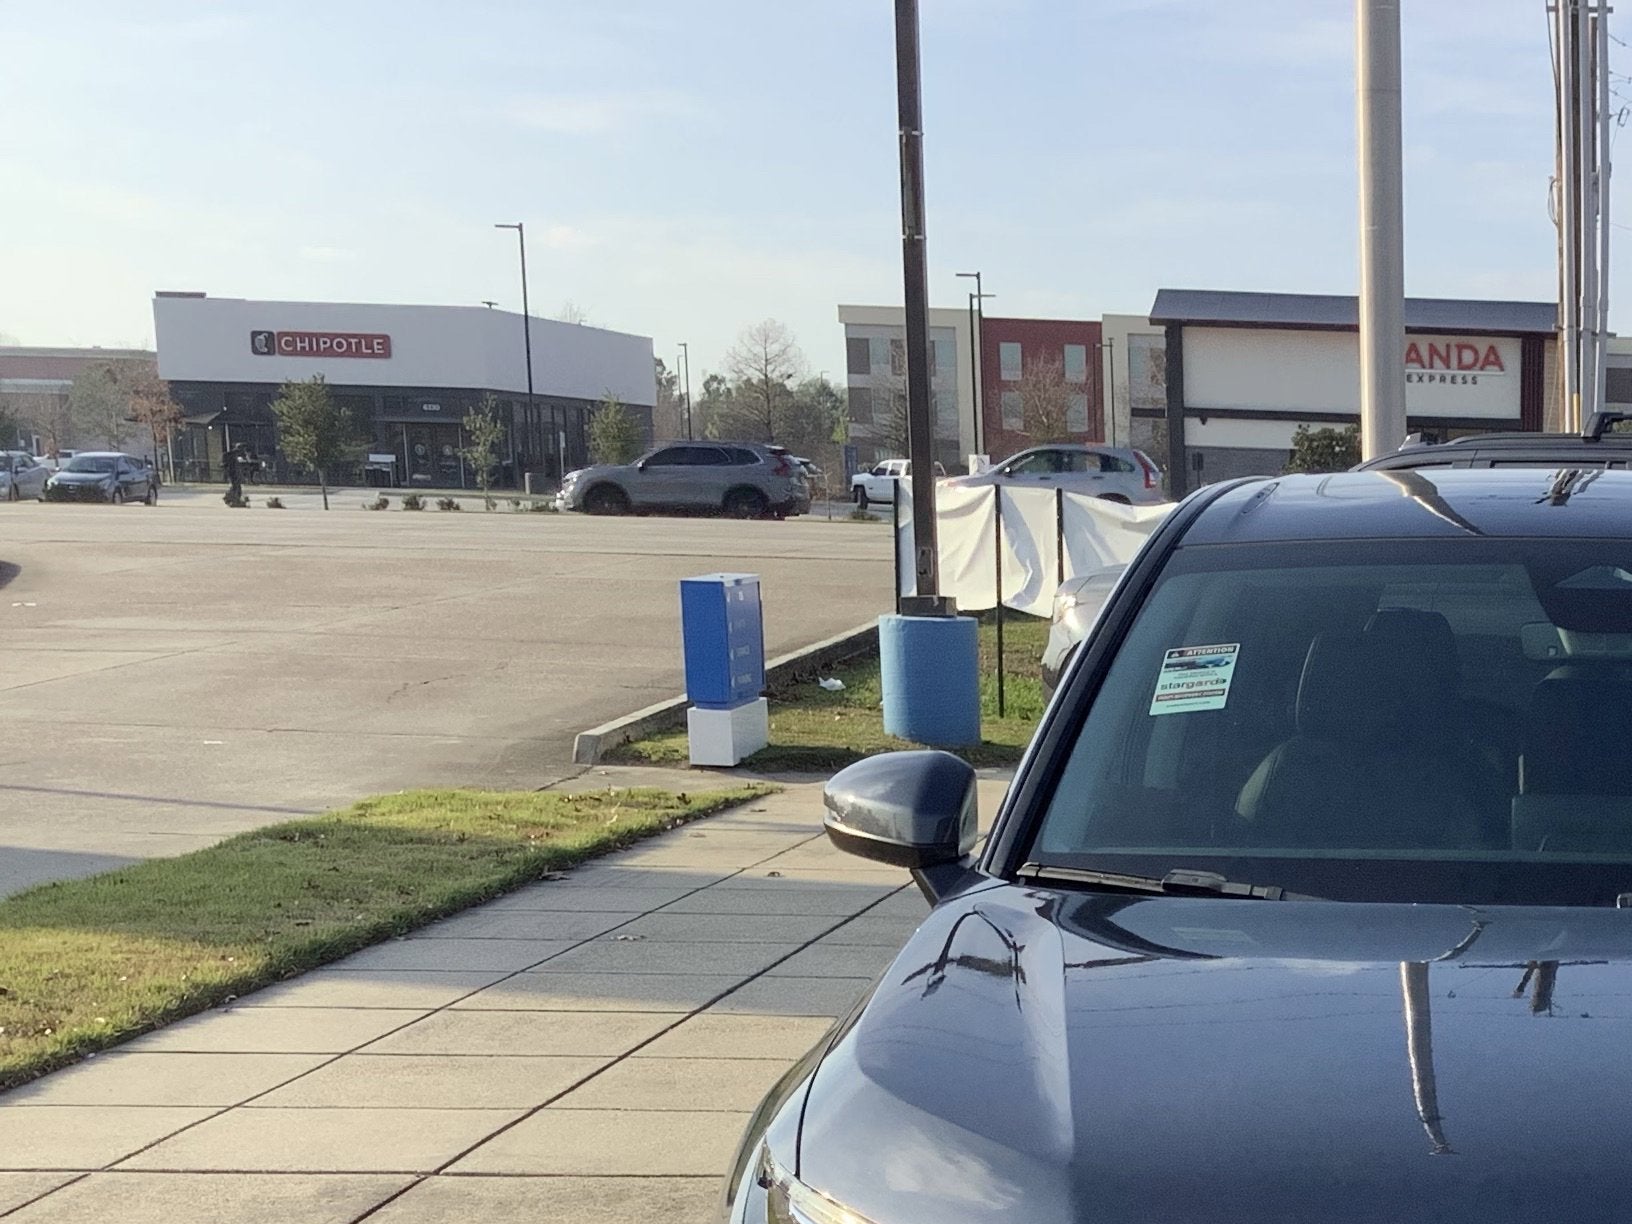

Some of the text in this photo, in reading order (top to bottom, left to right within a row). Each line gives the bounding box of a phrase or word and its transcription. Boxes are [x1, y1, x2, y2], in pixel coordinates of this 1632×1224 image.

[281, 336, 385, 354] CHIPOTLE
[1405, 342, 1505, 372] ANDA
[1406, 373, 1478, 385] EXPRESS
[1186, 646, 1234, 656] ATTENTION
